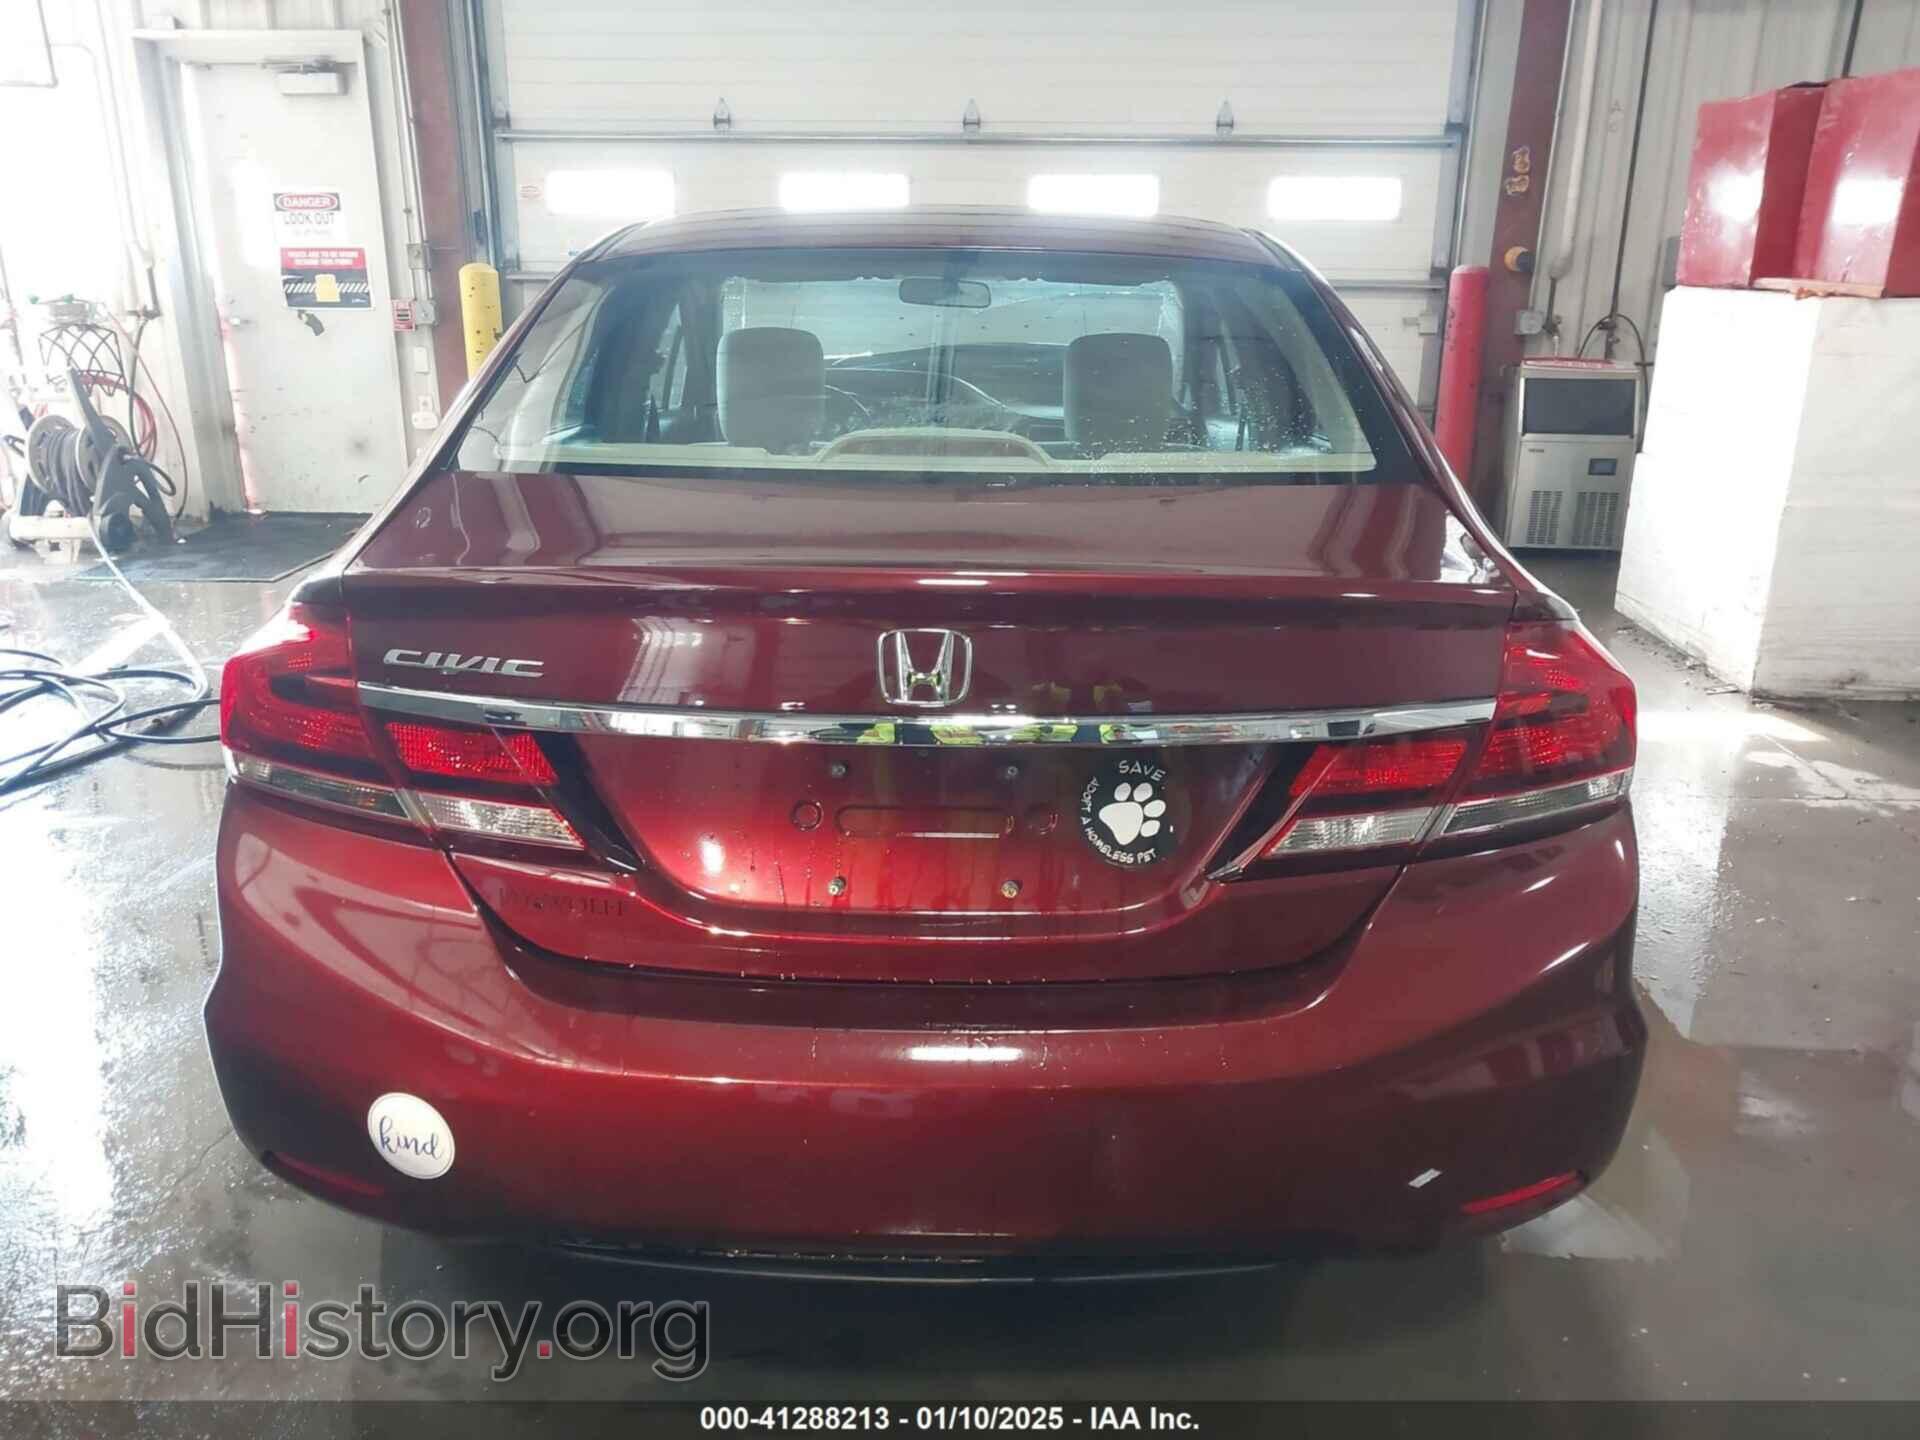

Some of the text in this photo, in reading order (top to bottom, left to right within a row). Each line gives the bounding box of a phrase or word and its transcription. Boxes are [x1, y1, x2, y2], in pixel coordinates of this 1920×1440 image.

[283, 197, 330, 208] DANGER
[283, 212, 335, 225] LOOK OUT
[383, 649, 544, 677] CIVIC
[1119, 760, 1166, 781] SAVE
[1081, 776, 1100, 813] ADOPT
[1080, 816, 1092, 825] A
[1085, 827, 1134, 864] HOMELESS
[1137, 848, 1157, 864] PET
[379, 1115, 443, 1160] kind
